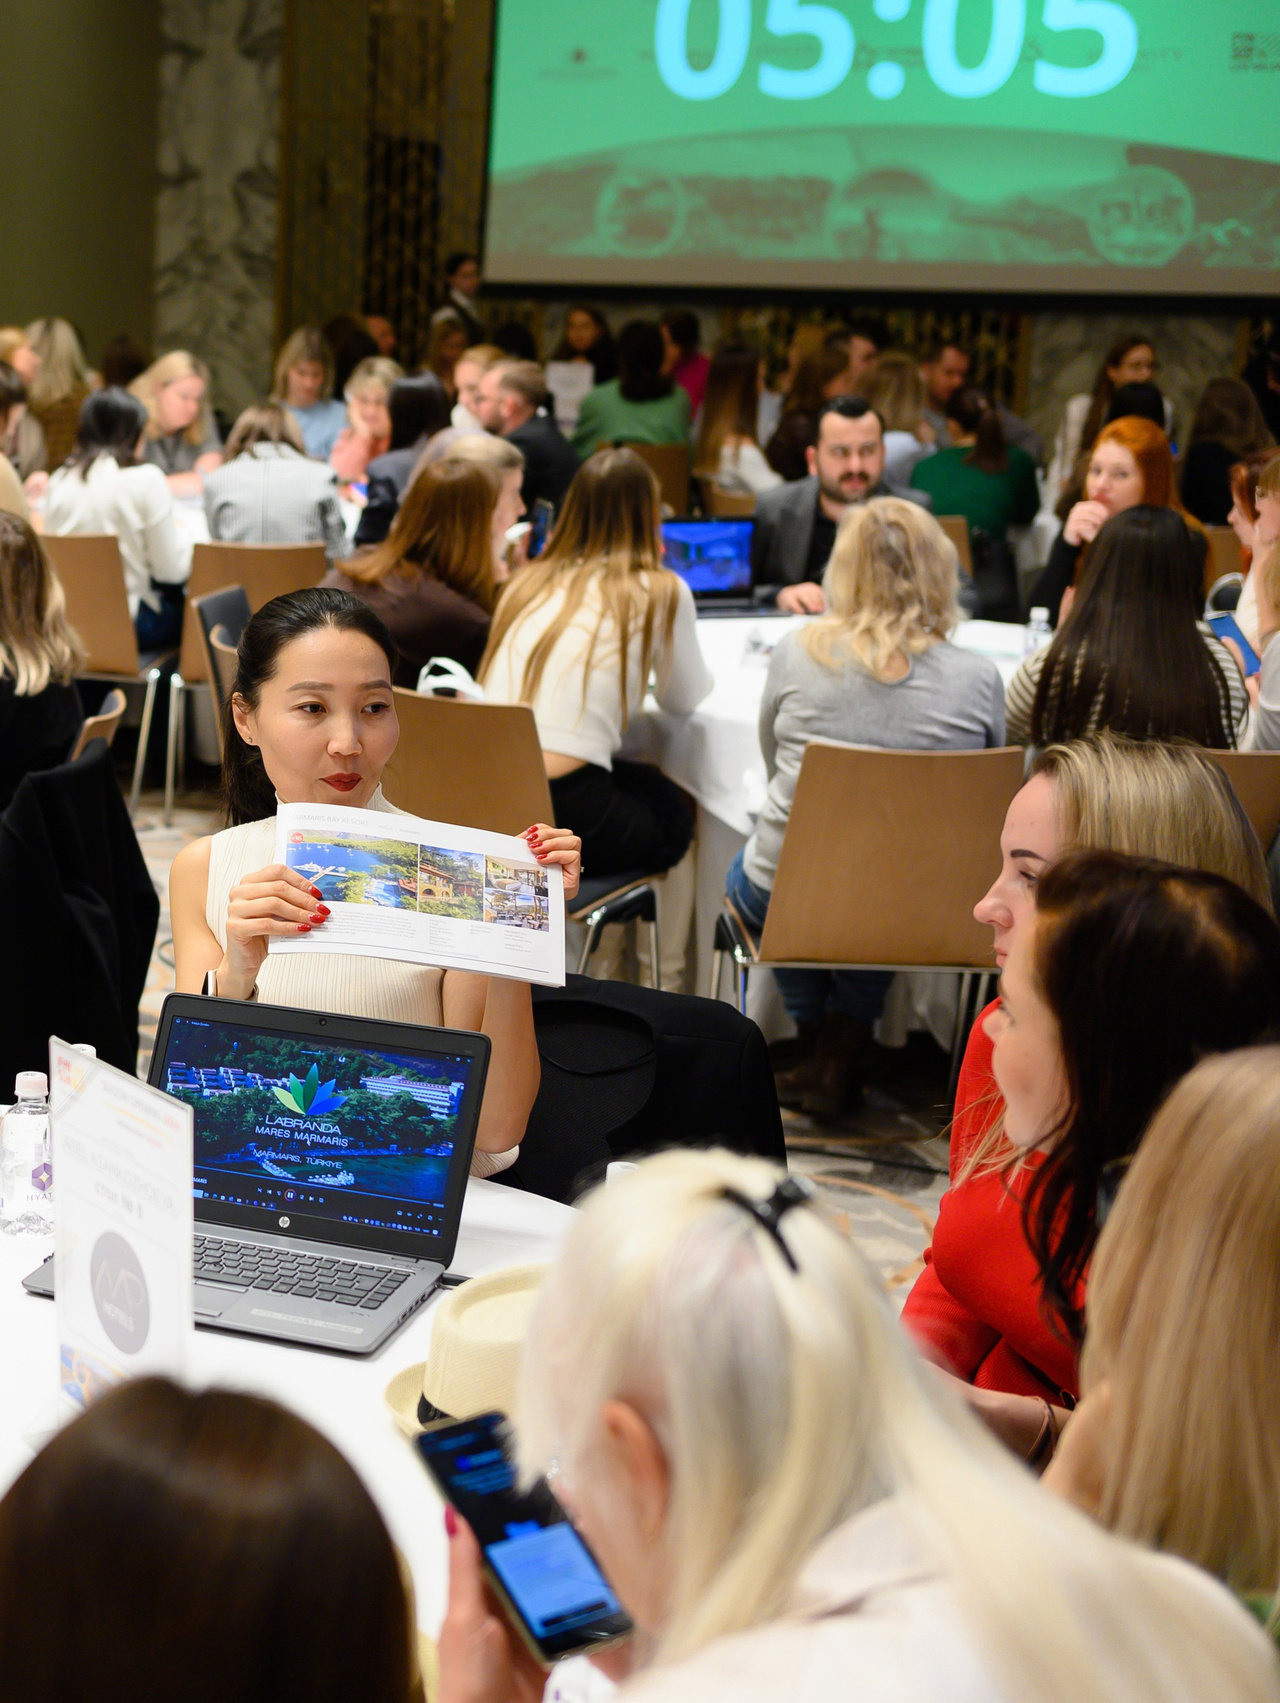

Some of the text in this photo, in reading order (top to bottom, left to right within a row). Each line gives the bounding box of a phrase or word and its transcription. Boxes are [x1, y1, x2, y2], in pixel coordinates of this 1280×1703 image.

[654, 0, 1138, 100] 05:05
[342, 817, 369, 826] RESORT
[265, 1114, 341, 1135] LABRANDA
[255, 1125, 349, 1147] MARES MARMARIS
[252, 1148, 302, 1163] MARMARIS,
[26, 1191, 52, 1201] HYAT
